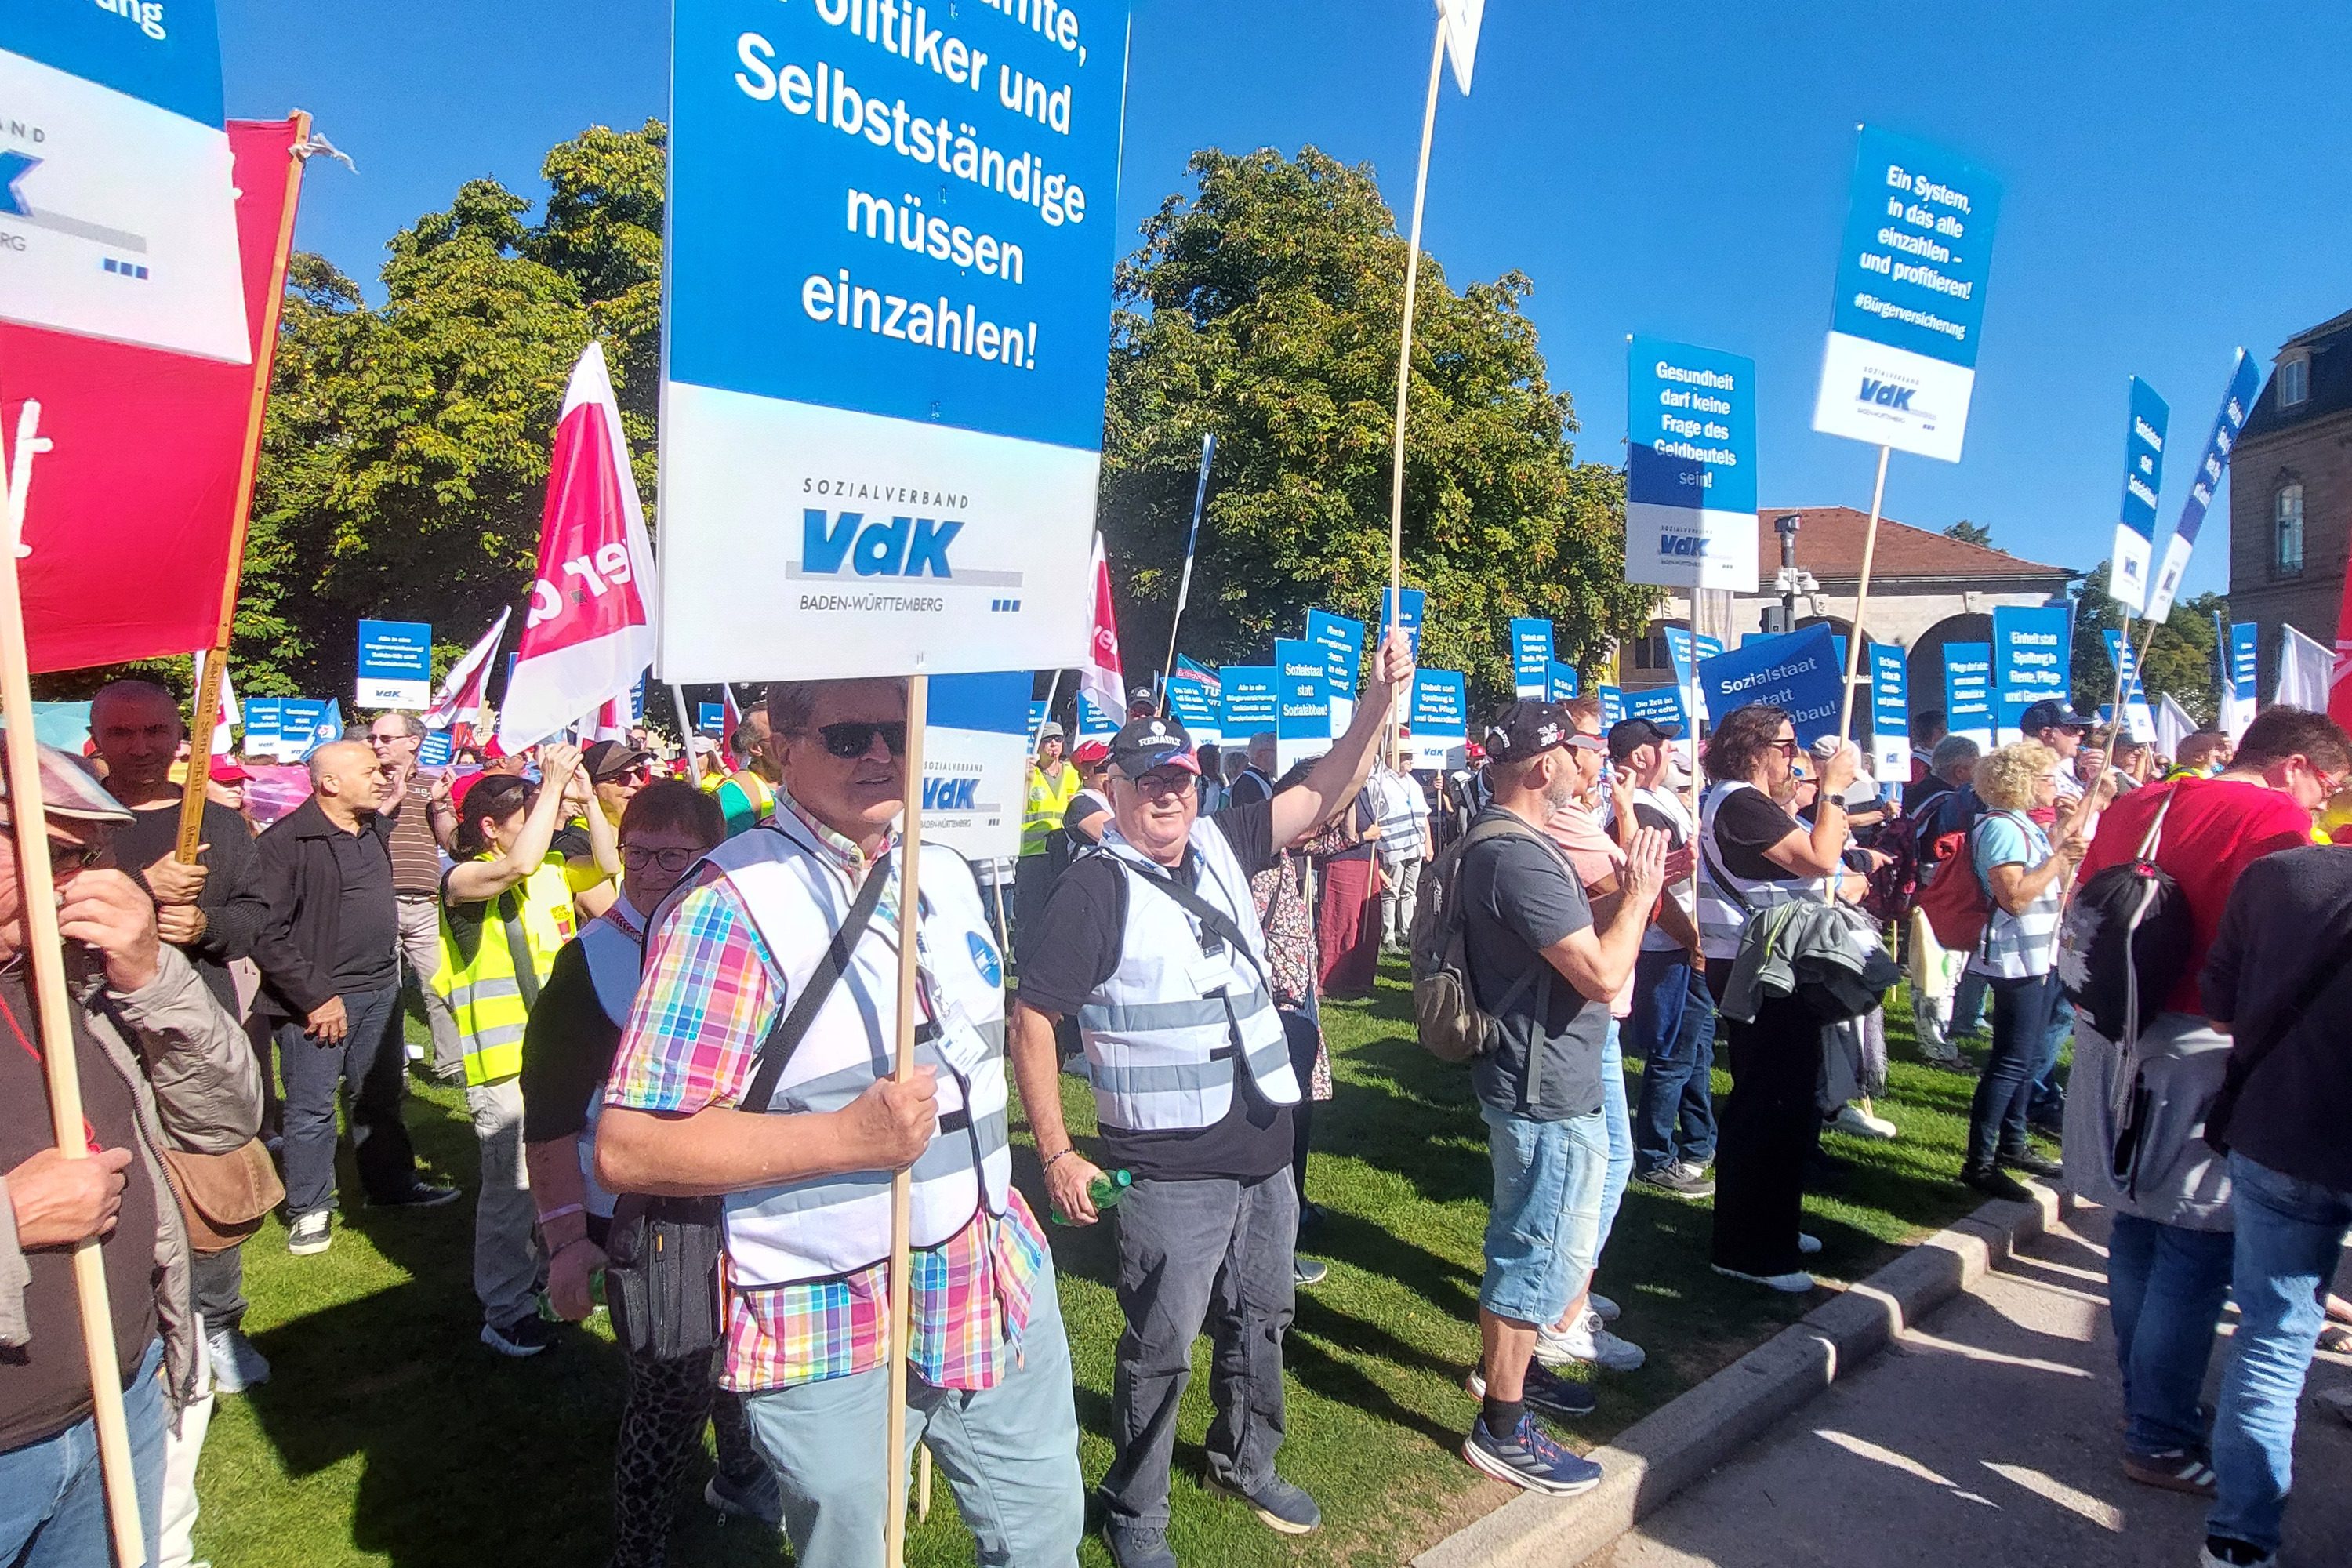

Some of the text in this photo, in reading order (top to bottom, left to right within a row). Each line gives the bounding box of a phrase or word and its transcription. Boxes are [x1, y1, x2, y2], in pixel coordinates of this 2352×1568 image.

[978, 0, 1087, 68] mte,
[815, 0, 1071, 135] olitiker und
[735, 31, 1086, 226] Selbstständige
[1886, 165, 1972, 214] Ein System,
[1888, 196, 1964, 238] in das alle
[848, 188, 1024, 284] müssen
[1878, 227, 1950, 264] einzahlen
[1860, 252, 1973, 300] und profitieren!
[802, 268, 1037, 370] einzahlen!
[1854, 292, 1966, 340] #Bürgerversicherung
[1655, 361, 1734, 390] Gesundheit
[1660, 389, 1730, 415] darf keine
[1860, 376, 1918, 412] VdK
[1661, 414, 1730, 440] Frage des
[1654, 439, 1737, 466] Geldbeutels
[802, 477, 970, 510] SOZIALVERBAND
[1679, 471, 1712, 488] sein!
[801, 507, 965, 579] VdK
[1661, 534, 1711, 557] VdK
[800, 593, 944, 612] BADEN-WÜRTTEMBERG
[1285, 662, 1323, 677] Sozialstaat
[1721, 657, 1818, 695] Sozialstaat
[1297, 684, 1314, 697] statt
[1283, 702, 1327, 717] Sozialabbau!
[1138, 735, 1181, 747] RENAULT
[1423, 747, 1444, 757] VdK
[924, 761, 983, 772] SOZIALVERBAND
[922, 777, 981, 810] VdK
